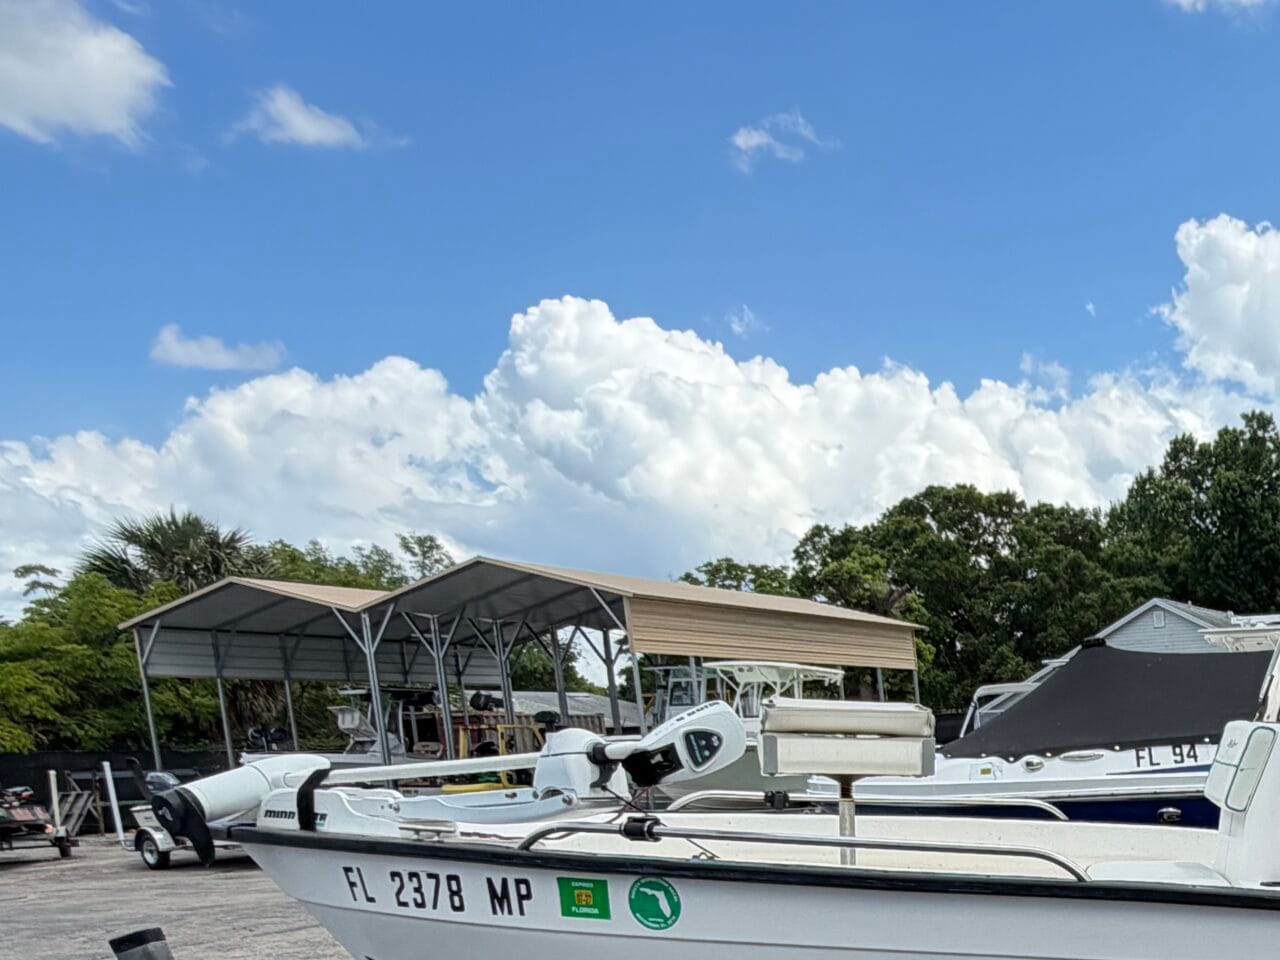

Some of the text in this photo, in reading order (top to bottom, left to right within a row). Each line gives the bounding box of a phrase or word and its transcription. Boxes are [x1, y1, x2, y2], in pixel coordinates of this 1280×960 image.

[1135, 744, 1198, 767] FL 94
[342, 866, 533, 917] FL 2378 MP
[571, 906, 599, 914] FLORIDA
